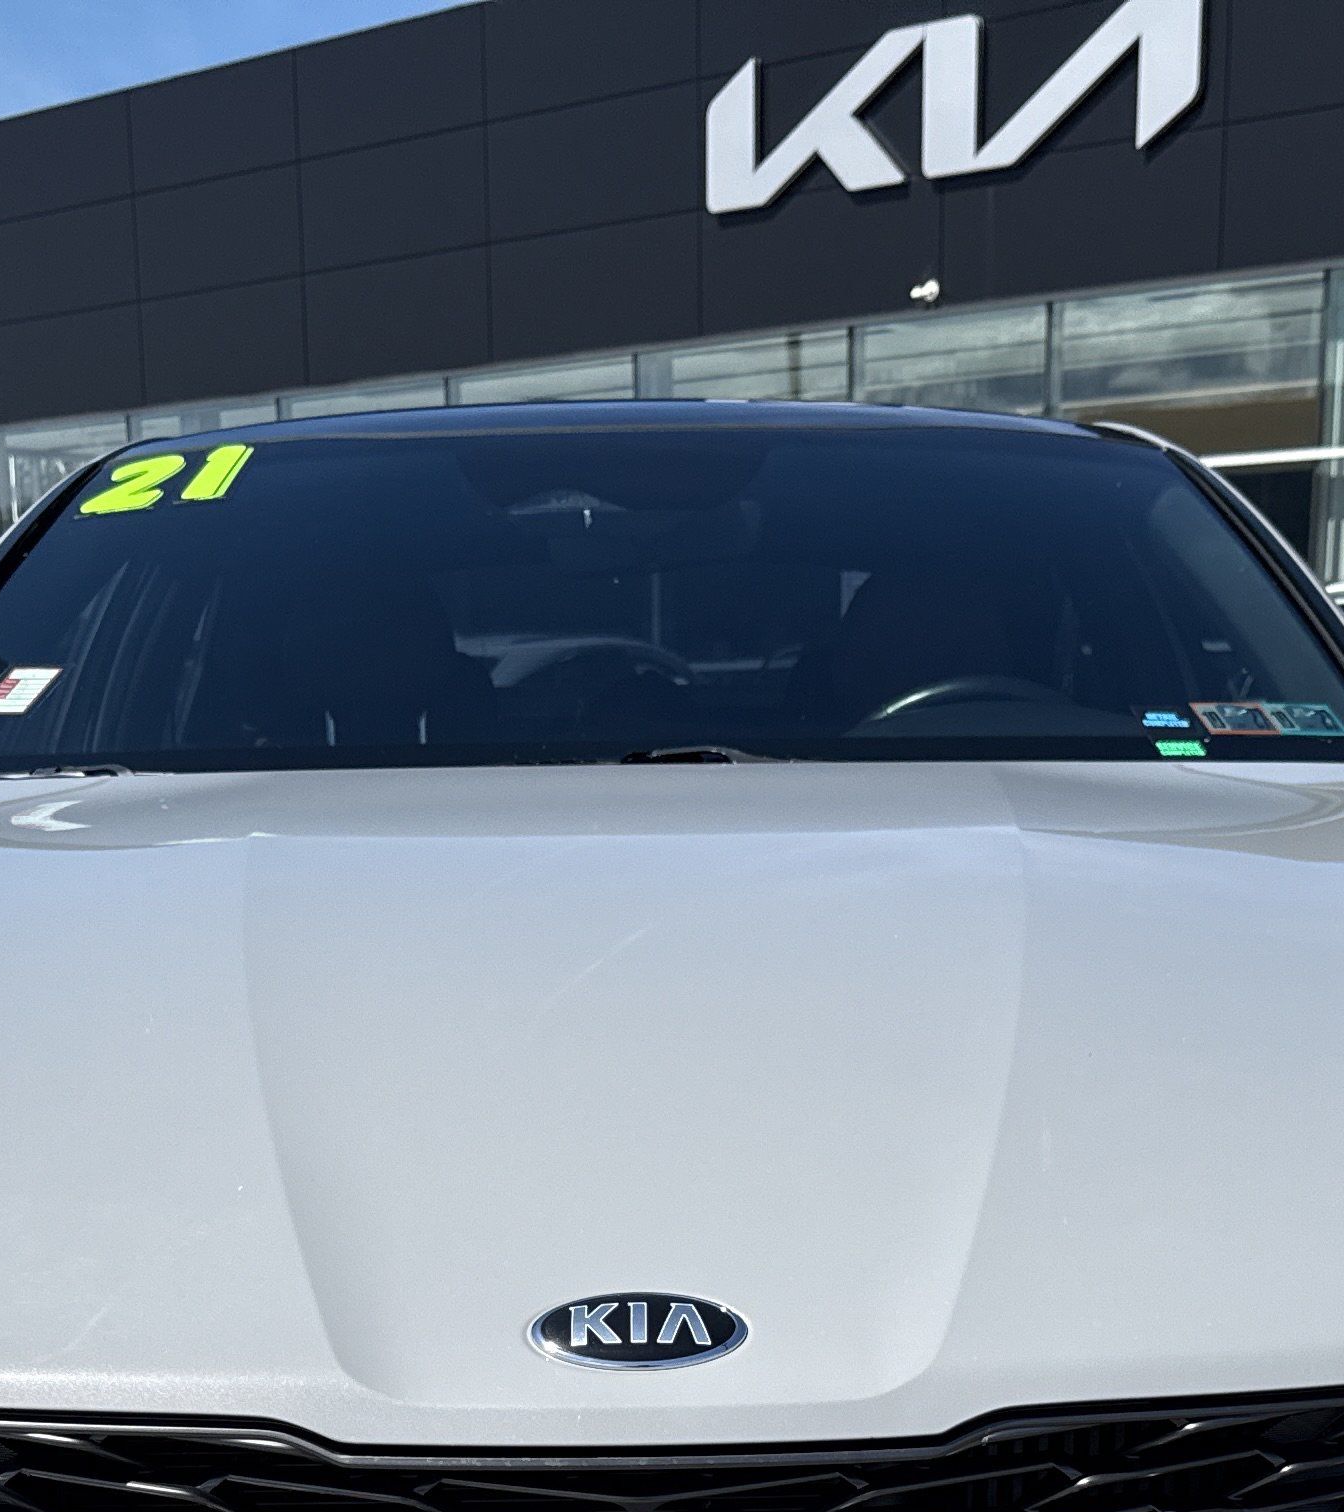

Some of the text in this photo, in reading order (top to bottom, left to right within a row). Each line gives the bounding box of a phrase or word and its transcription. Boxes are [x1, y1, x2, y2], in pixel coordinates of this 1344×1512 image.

[706, 0, 1203, 214] KIA
[79, 444, 255, 515] 21
[568, 1301, 712, 1347] KIA
